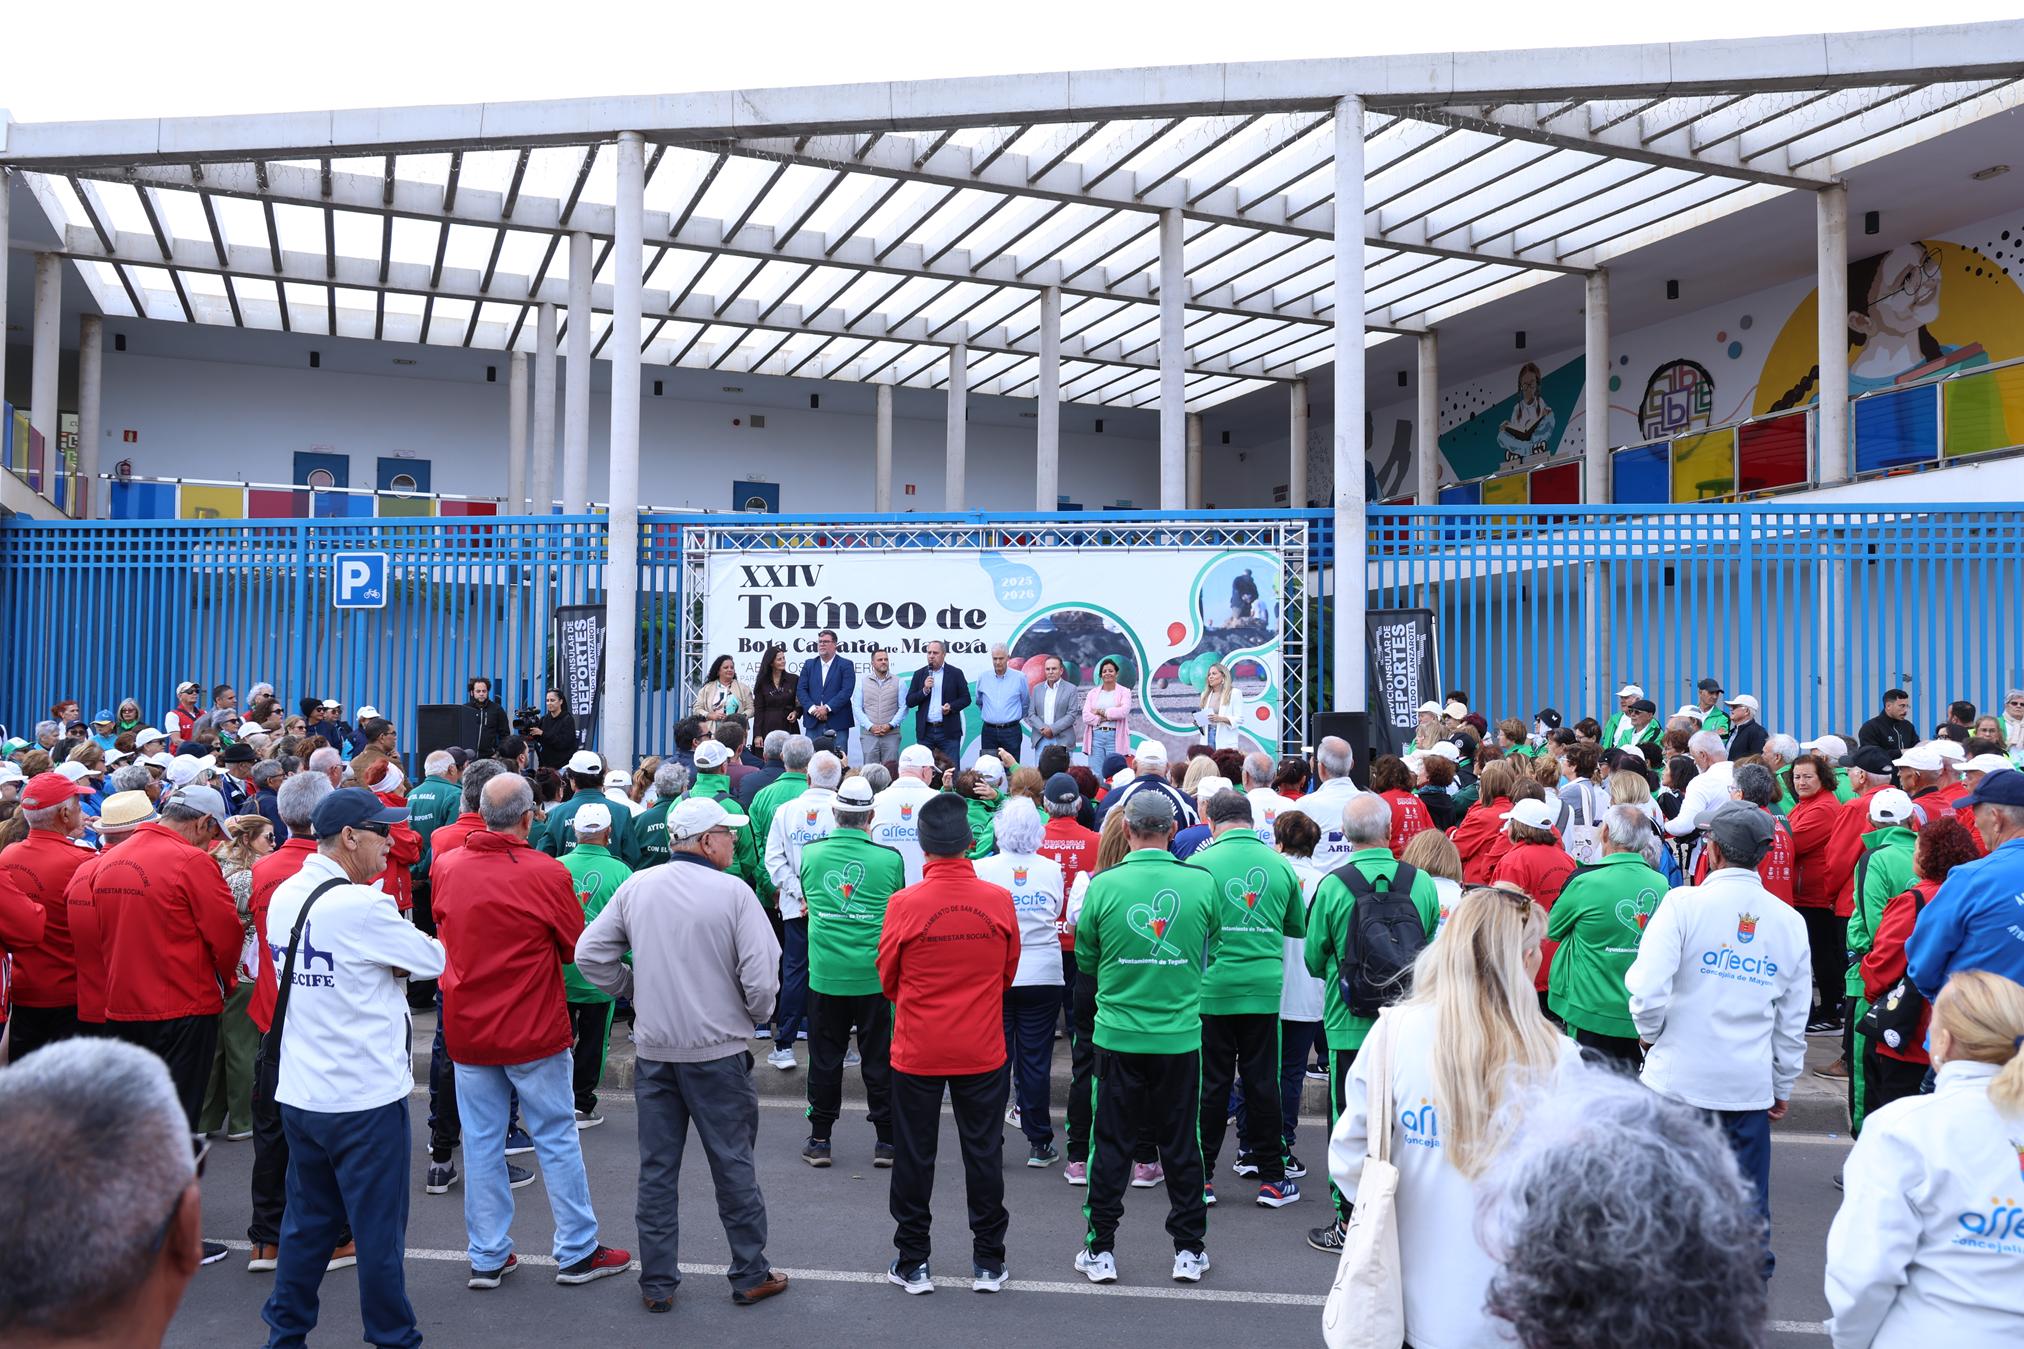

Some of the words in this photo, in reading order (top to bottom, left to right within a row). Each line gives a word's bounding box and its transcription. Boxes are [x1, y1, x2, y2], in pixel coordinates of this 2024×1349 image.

[342, 561, 371, 599] P
[739, 564, 824, 588] XXIV
[1001, 576, 1033, 587] 2025
[1002, 590, 1035, 600] 2026
[738, 594, 927, 630] Torneo
[936, 603, 988, 630] de
[567, 621, 574, 633] DE
[1383, 625, 1391, 638] DE
[568, 635, 577, 673] INSULAR
[793, 637, 879, 653] Caaria
[574, 619, 590, 715] DEPORTES
[1384, 640, 1393, 681] INSULAR
[1391, 624, 1410, 728] DEPORTES
[1409, 676, 1416, 687] DE
[570, 674, 579, 715] SERVICIO
[647, 823, 665, 833] AYTO
[927, 934, 965, 942] BIENESTAR
[966, 933, 991, 941] SOCIAL
